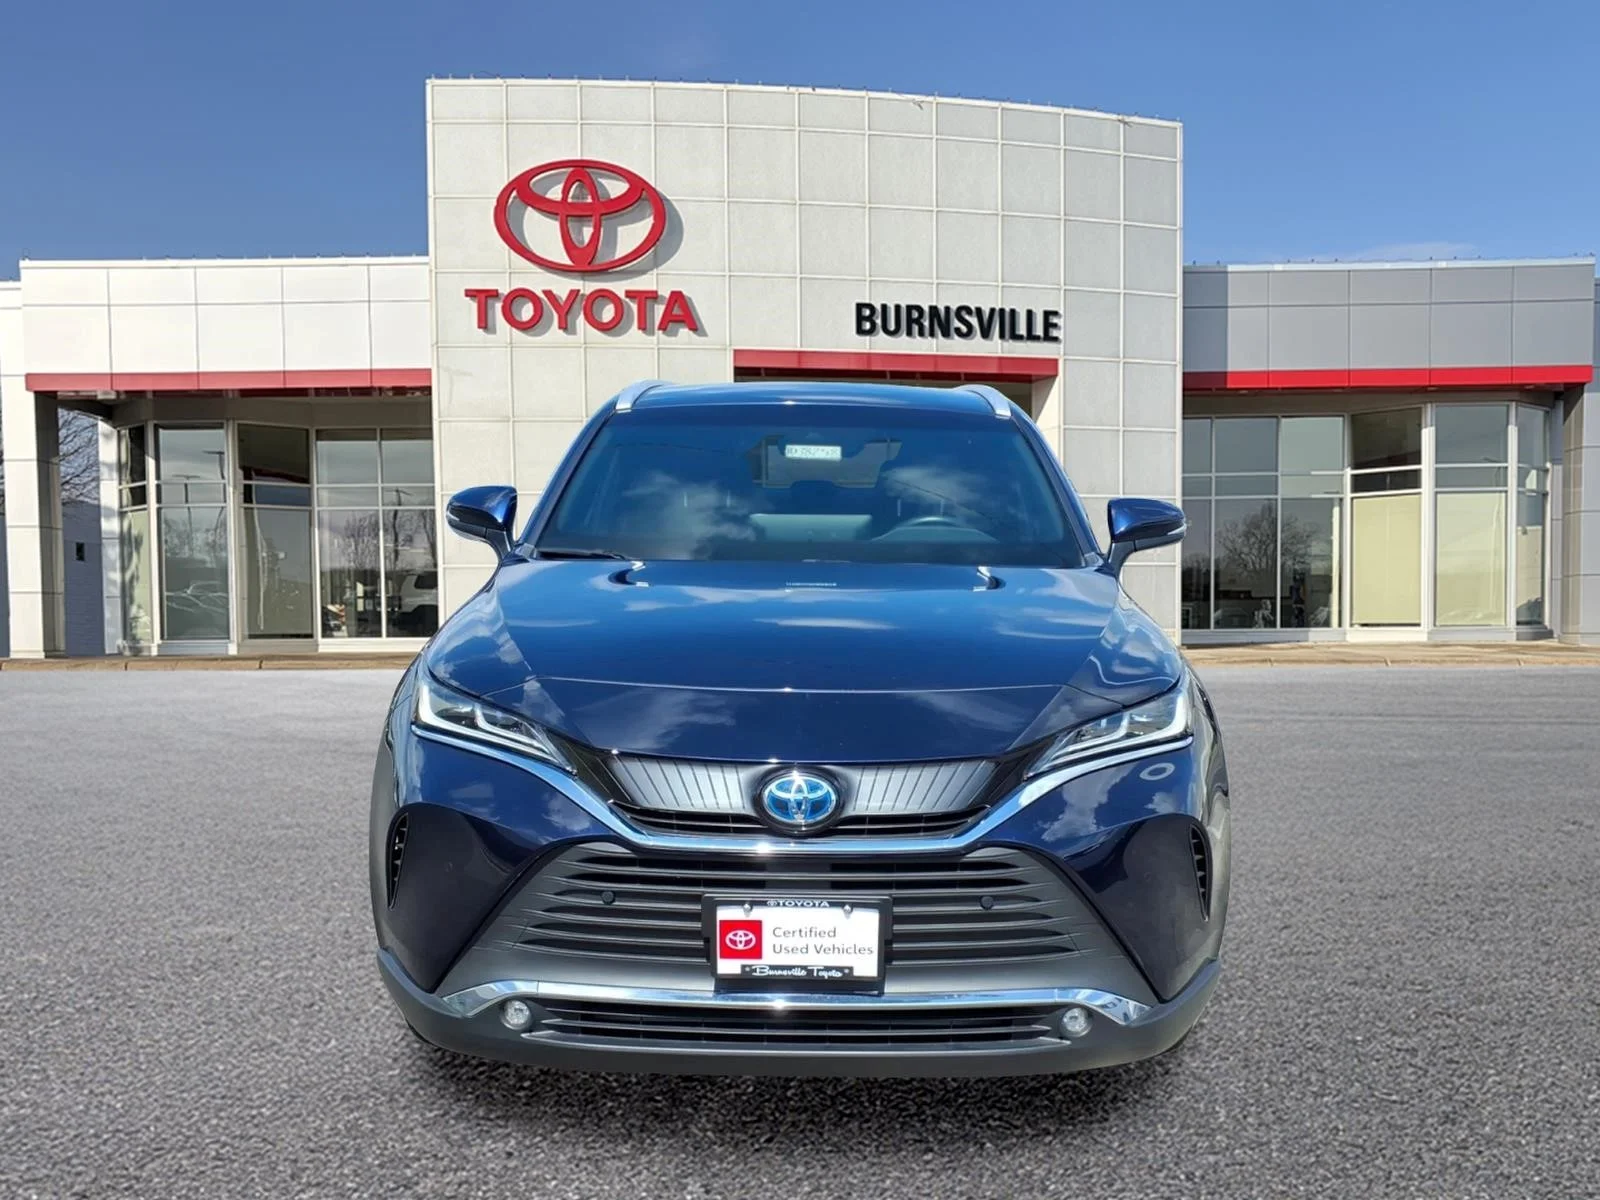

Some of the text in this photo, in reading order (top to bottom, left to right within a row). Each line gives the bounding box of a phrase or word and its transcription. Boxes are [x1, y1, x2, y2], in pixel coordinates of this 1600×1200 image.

[465, 288, 699, 332] TOYOTA
[855, 302, 1061, 342] BURNSVILLE
[778, 900, 830, 908] TOYOTA
[772, 927, 837, 938] Certified
[772, 943, 874, 955] Used Vehicles
[752, 966, 843, 979] Burnsville Toyota
